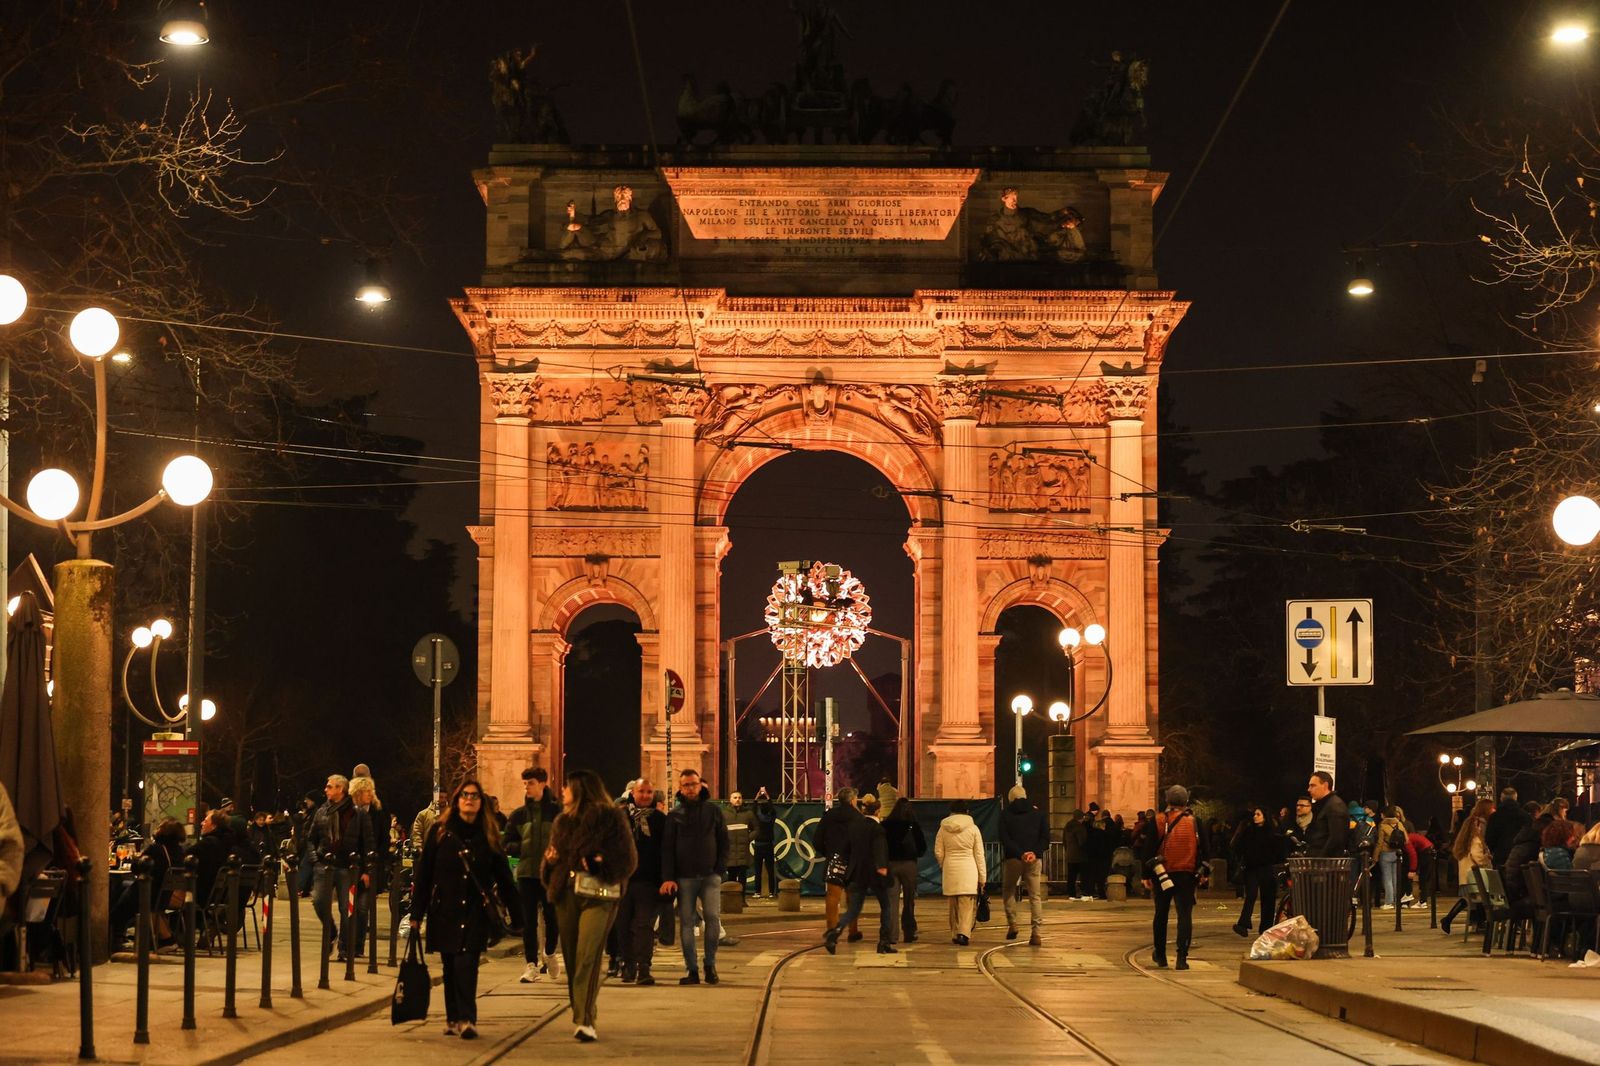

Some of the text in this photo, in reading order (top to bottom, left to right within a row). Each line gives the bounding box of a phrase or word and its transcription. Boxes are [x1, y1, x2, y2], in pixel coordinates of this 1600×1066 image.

[739, 199, 789, 207] ENTRANDO
[827, 199, 850, 207] ARMI
[857, 199, 902, 207] GLORIOSE
[683, 208, 738, 216] NAPOLEONE
[745, 208, 756, 216] III
[775, 208, 821, 216] VITTORIO
[827, 209, 878, 217] EMANUELE
[885, 209, 892, 217] II
[899, 209, 957, 217] LIBERATORI
[699, 217, 737, 225] MILANO
[743, 217, 794, 226] ESULTANTE
[853, 218, 864, 226] DA
[871, 218, 904, 226] QUESTI
[909, 218, 940, 226] MARMI
[765, 227, 874, 236] LE IMPRONTE SERVILI
